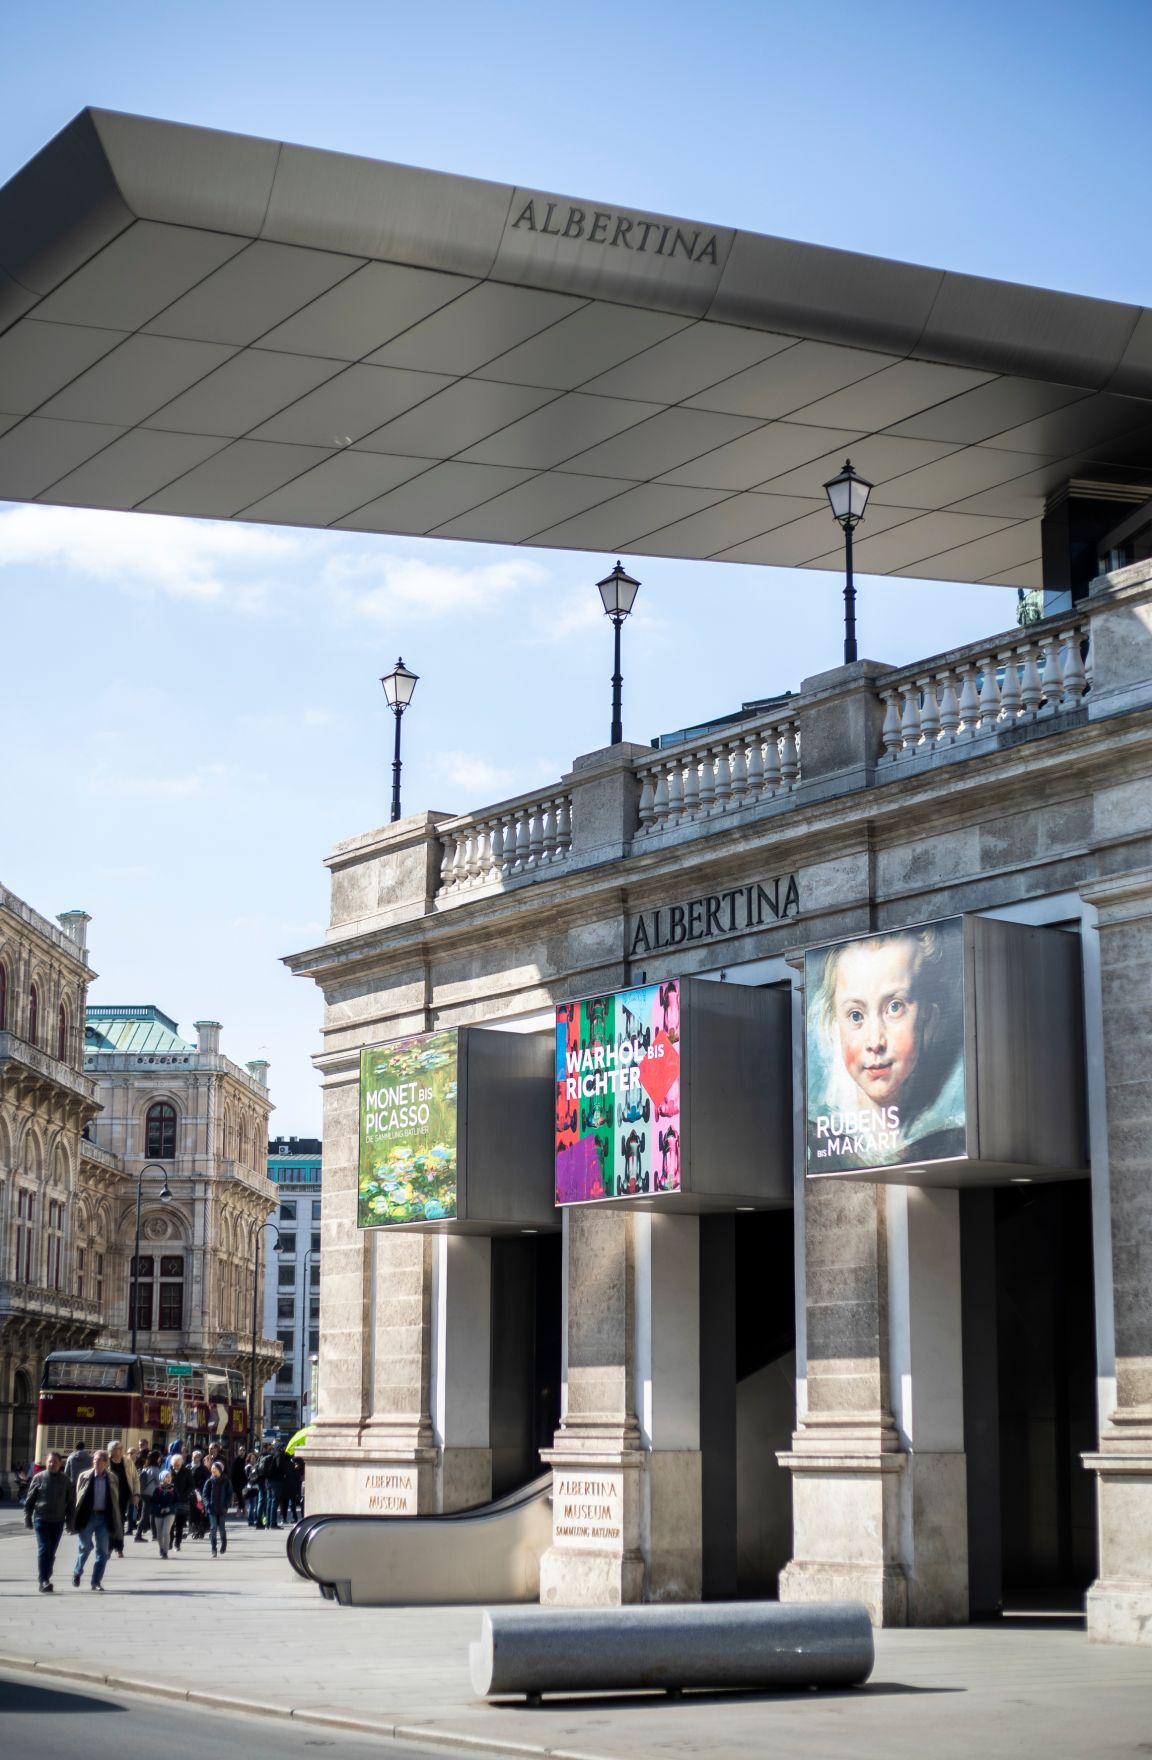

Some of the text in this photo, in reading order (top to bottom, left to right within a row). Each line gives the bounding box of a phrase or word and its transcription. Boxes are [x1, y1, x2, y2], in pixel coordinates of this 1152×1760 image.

[512, 199, 719, 265] ALBERTINA
[630, 874, 799, 955] ALBERTINA
[566, 1040, 665, 1073] WARHOL BIS
[366, 1082, 433, 1111] MONET BIS
[566, 1066, 641, 1101] RICHTER
[366, 1104, 430, 1134] PICASSO
[816, 1105, 900, 1139] RUBENS
[817, 1131, 900, 1158] BIS MAKART
[365, 1474, 413, 1489] ALBERTINA
[559, 1480, 617, 1497] ALBERTINA
[369, 1495, 408, 1511] MUSEUM
[564, 1504, 612, 1521] MUSEUM
[556, 1526, 590, 1538] SAMMLUNG
